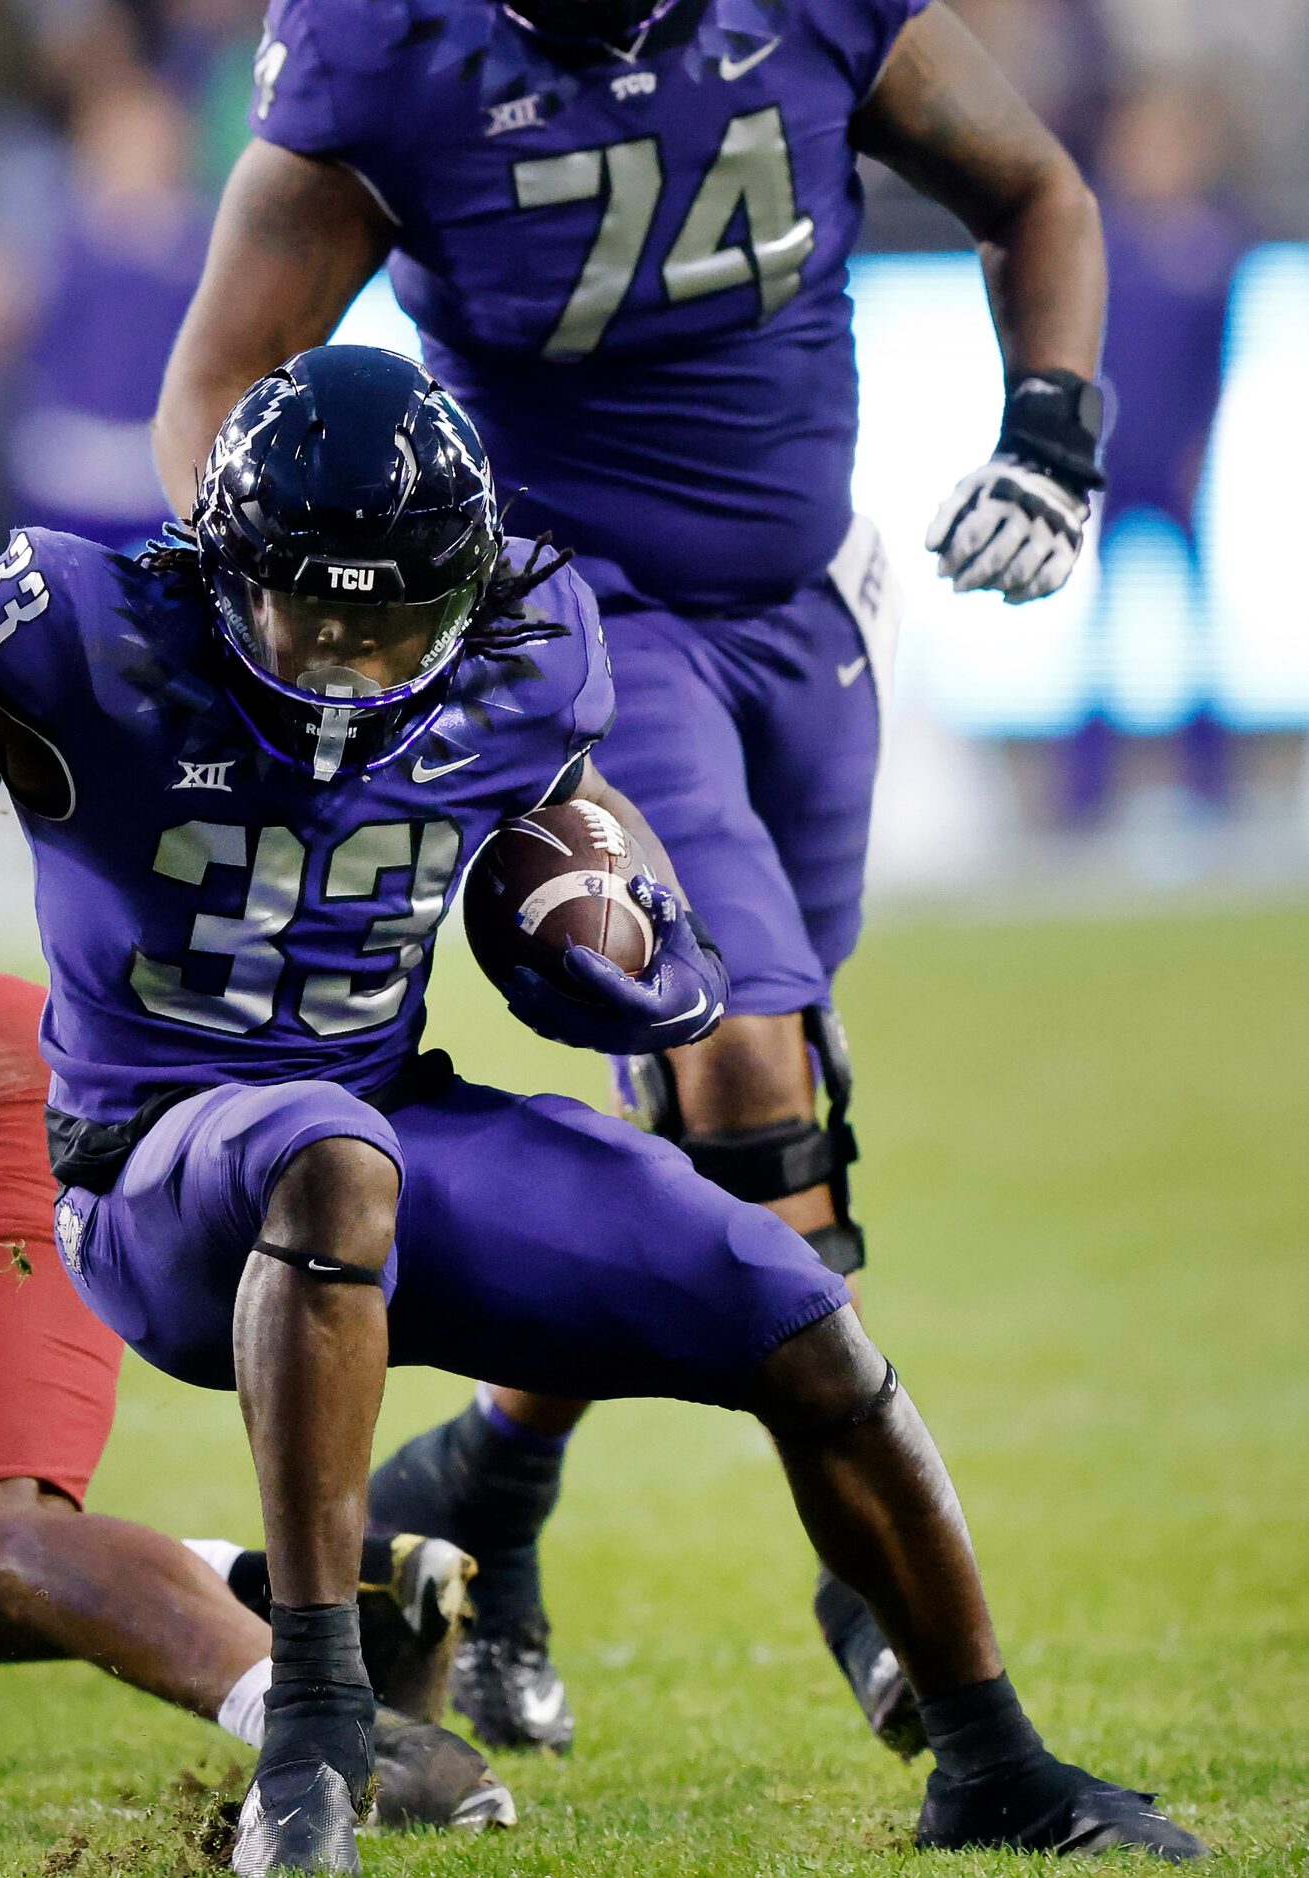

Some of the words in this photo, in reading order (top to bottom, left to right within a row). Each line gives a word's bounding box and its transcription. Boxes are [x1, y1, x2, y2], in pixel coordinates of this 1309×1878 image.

[610, 72, 656, 101] TCU
[512, 105, 815, 360] 74
[327, 566, 375, 592] TCU
[172, 759, 236, 793] XII
[636, 882, 653, 908] TCU
[129, 819, 460, 1036] 33
